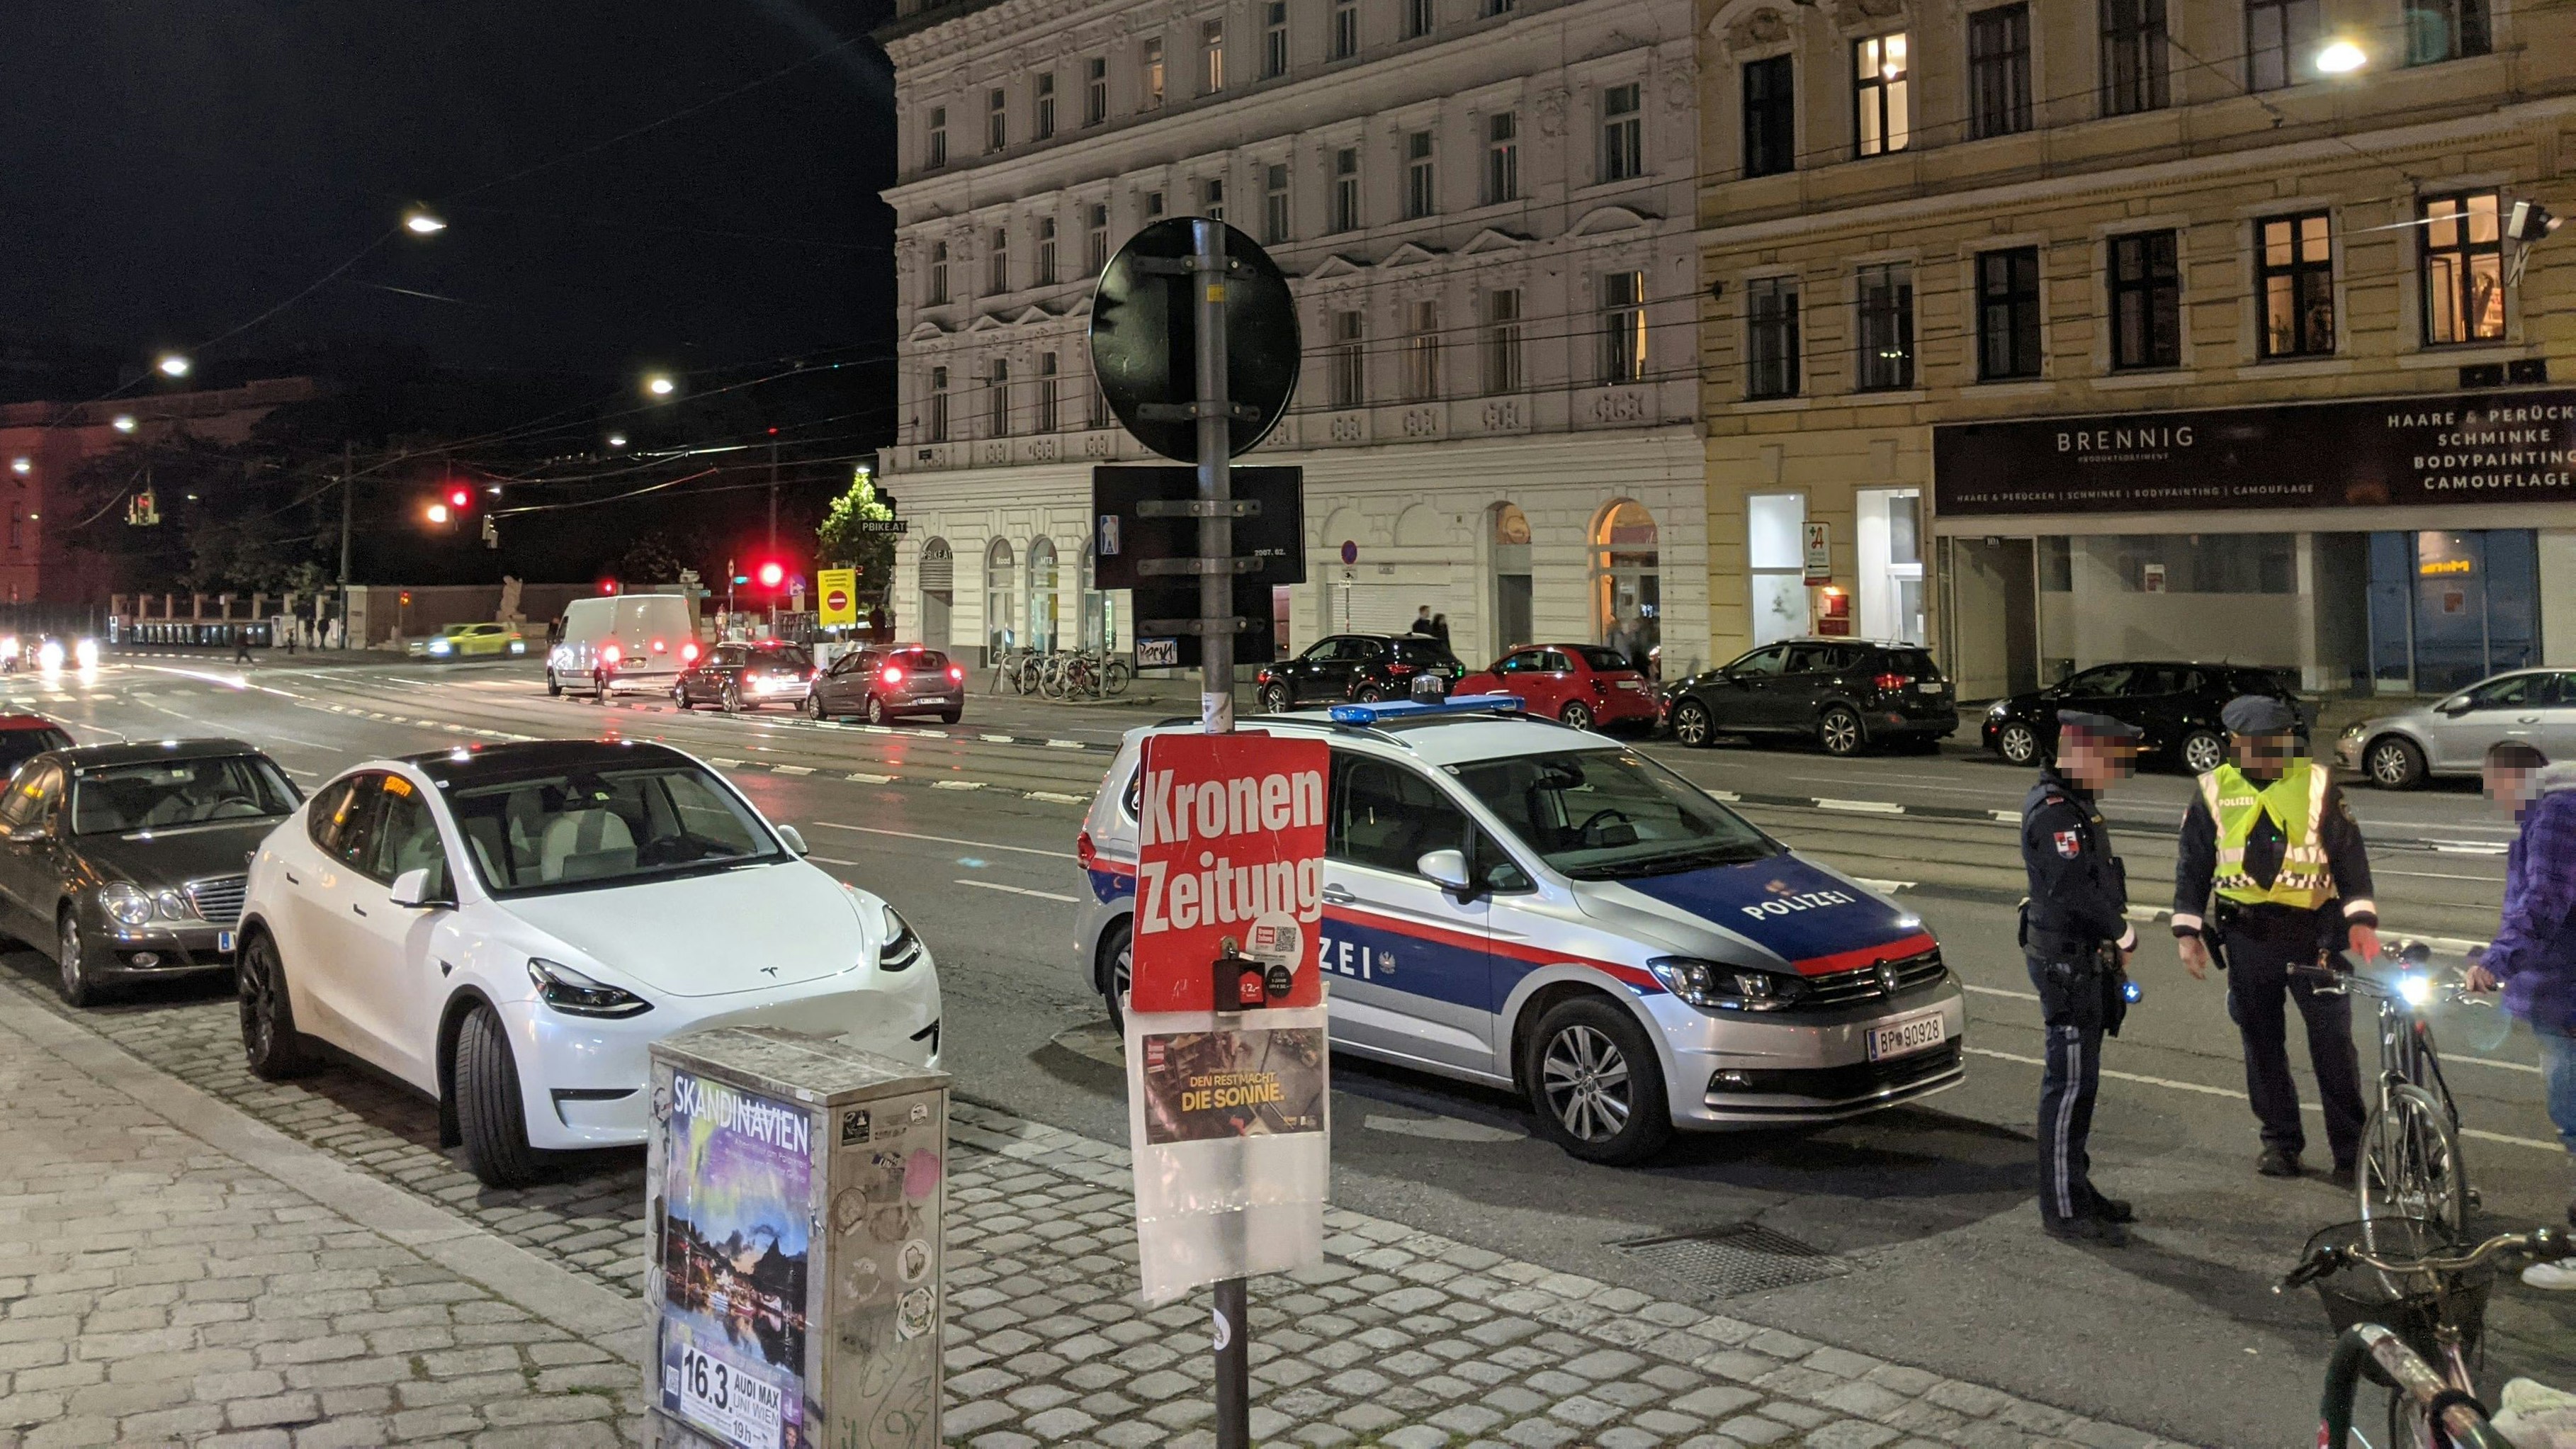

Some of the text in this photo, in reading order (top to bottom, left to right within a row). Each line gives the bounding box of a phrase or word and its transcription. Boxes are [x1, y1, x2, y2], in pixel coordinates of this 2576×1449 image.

[2387, 412, 2456, 428] HAARE
[2465, 410, 2478, 424] &
[2057, 427, 2194, 451] BRENNIG
[2438, 428, 2552, 447] SCHMINKE
[2413, 449, 2576, 469] BODYPAINTING
[2067, 489, 2122, 500] SCHMINKE
[2134, 487, 2220, 498] BODYPAINTING
[2232, 484, 2315, 496] CAMOUFLAGE
[2424, 472, 2571, 490] CAMOUFLAGE
[862, 521, 905, 532] PBIKE.AT
[1141, 769, 1324, 847] Kronen
[2218, 796, 2254, 807] POLIZEI
[1141, 850, 1326, 935] Zeitung
[1741, 890, 1857, 921] POLIZEI
[1880, 1019, 1940, 1054] BP 90928
[1190, 1071, 1276, 1088] DEN REST MACHT
[1182, 1083, 1285, 1112] DIE SONNE.
[674, 1075, 808, 1156] SKANDINAVIEN
[684, 1348, 733, 1414] 16.3.
[734, 1373, 779, 1411] AUDI MAX
[733, 1392, 750, 1414] UNI
[752, 1402, 779, 1428] WIEN
